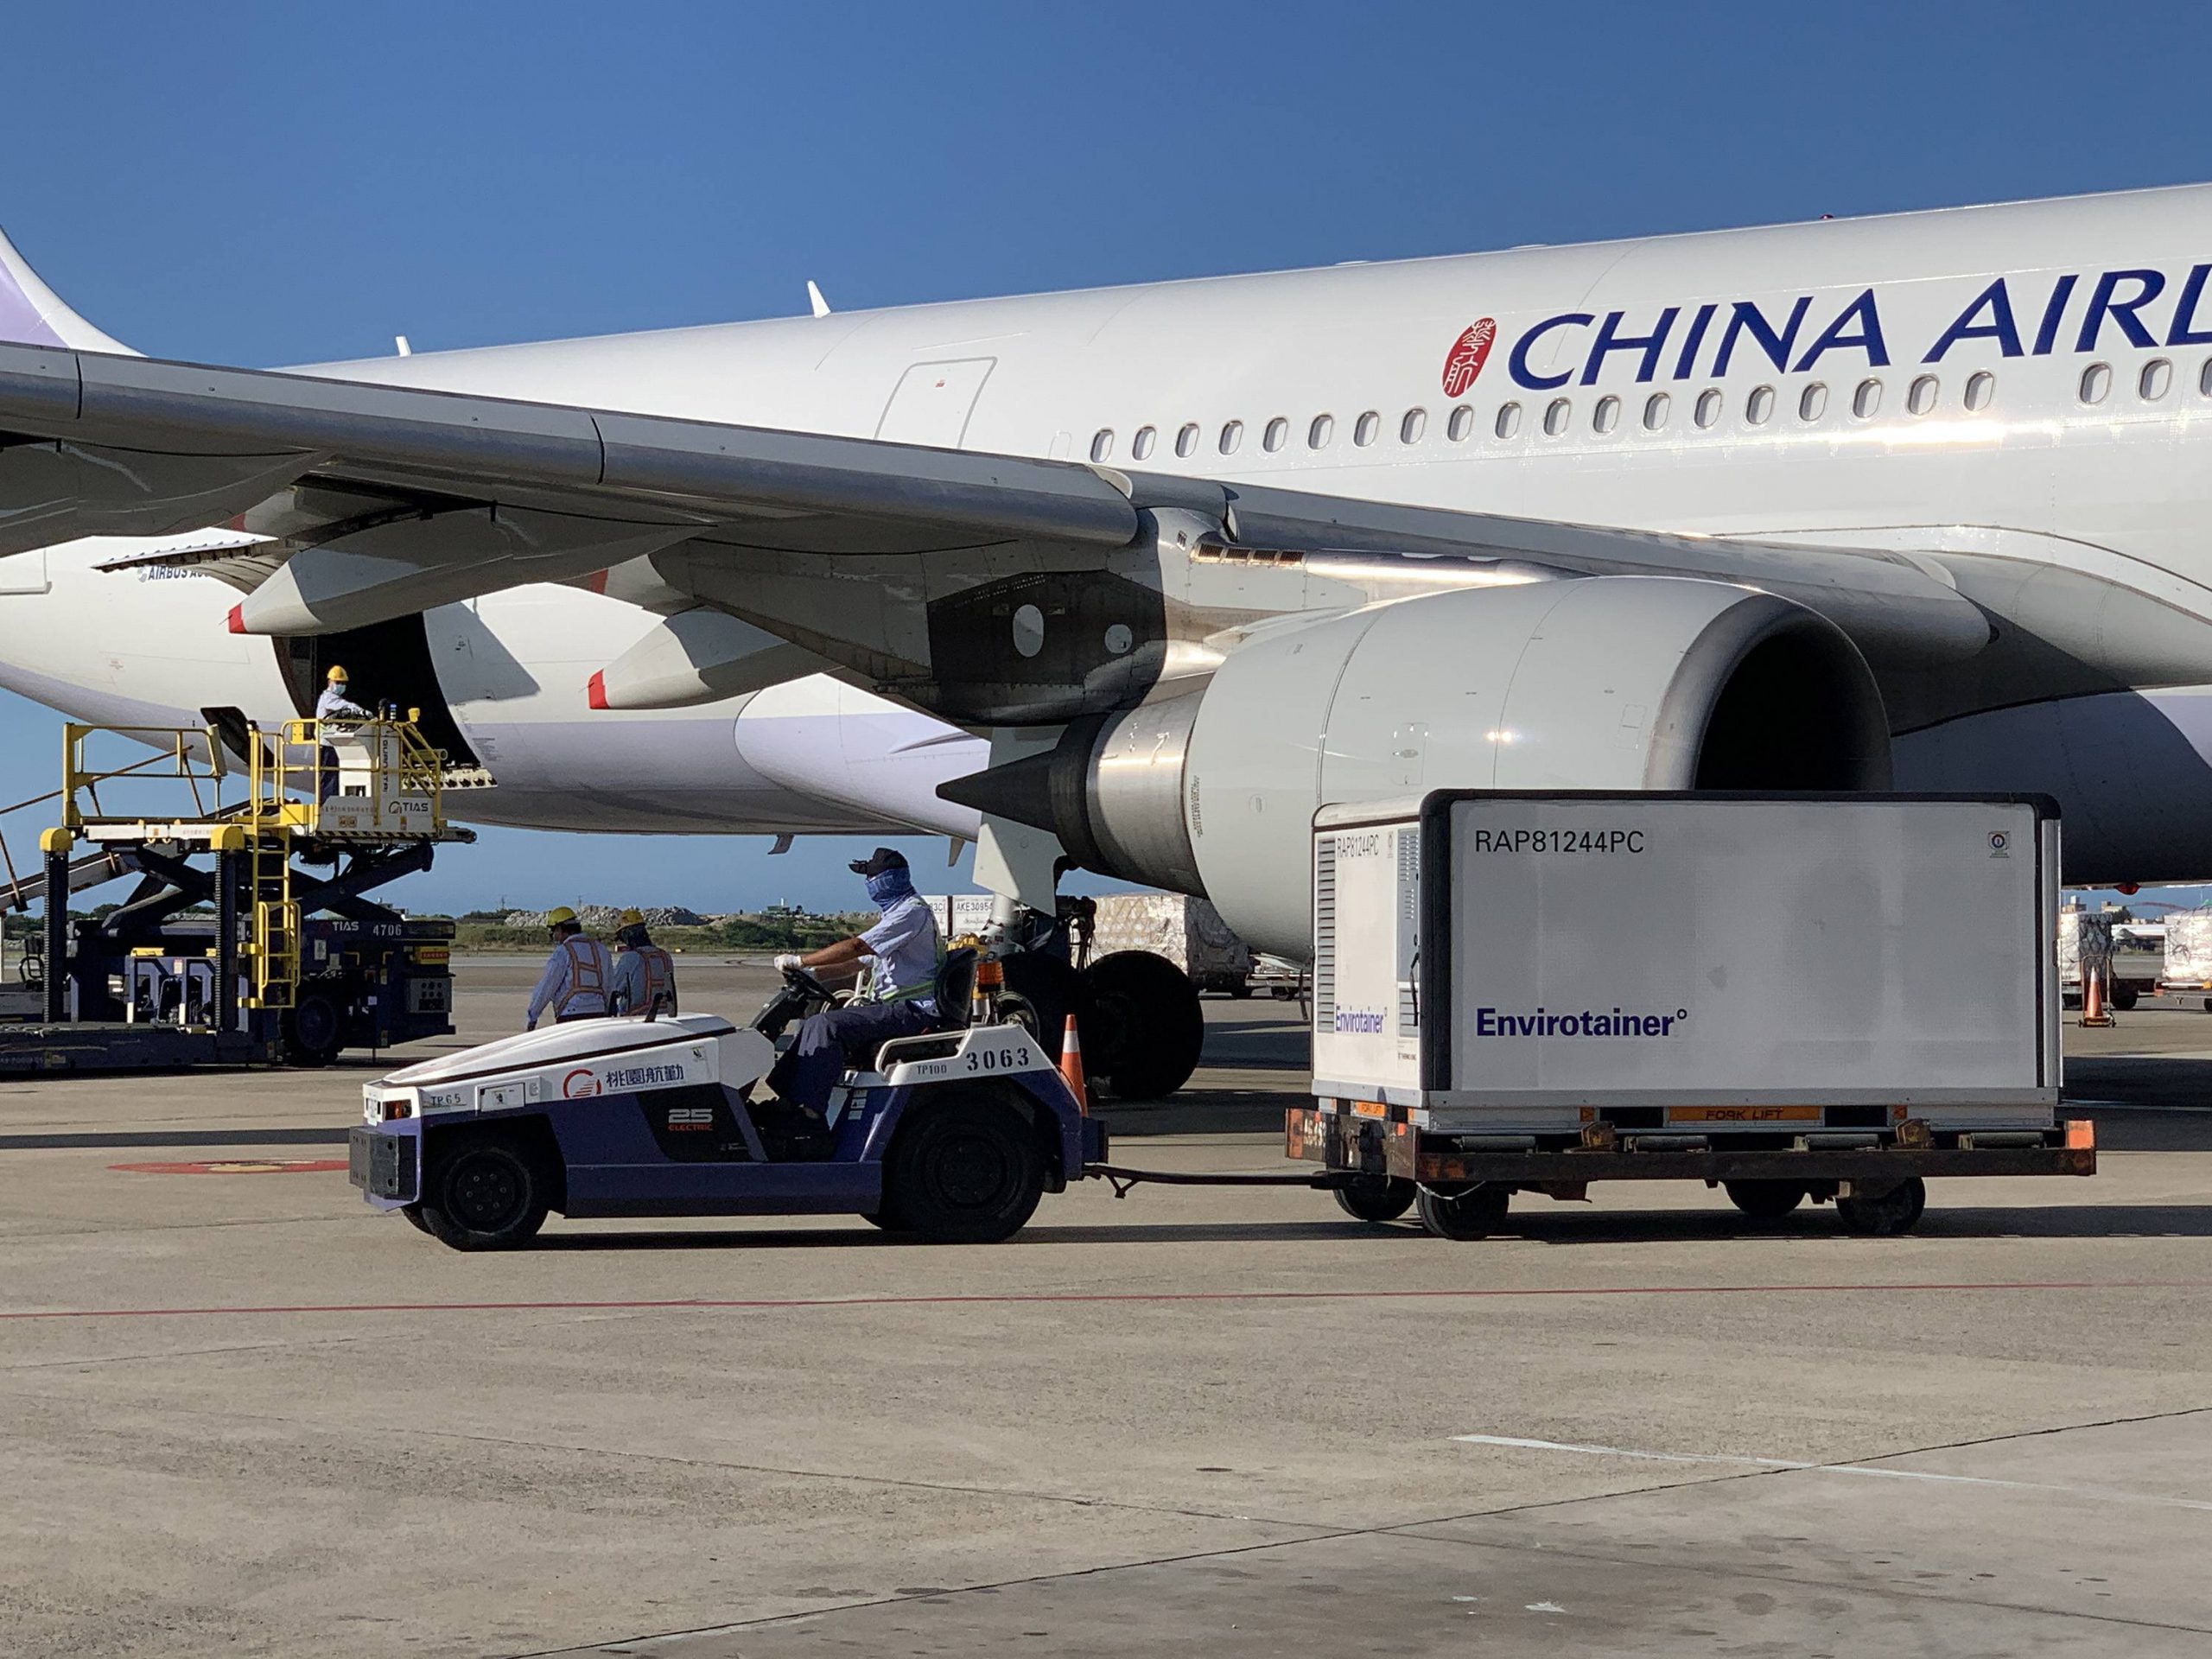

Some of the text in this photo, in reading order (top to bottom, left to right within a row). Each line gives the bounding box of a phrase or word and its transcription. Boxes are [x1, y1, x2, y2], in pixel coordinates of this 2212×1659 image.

[1508, 264, 2212, 391] CHINA AIRL
[148, 566, 188, 580] AIRBUS
[403, 802, 429, 811] TIAS
[1337, 834, 1379, 857] RAP81244PC
[1476, 830, 1644, 853] RAP81244PC
[333, 921, 359, 931] TIAS
[372, 925, 402, 936] 4706
[966, 1047, 1029, 1071] 3063
[606, 1064, 684, 1088] 桃園航勤
[917, 1065, 947, 1075] TP100
[668, 1109, 714, 1123] 25
[1752, 1109, 1784, 1121] LIFT
